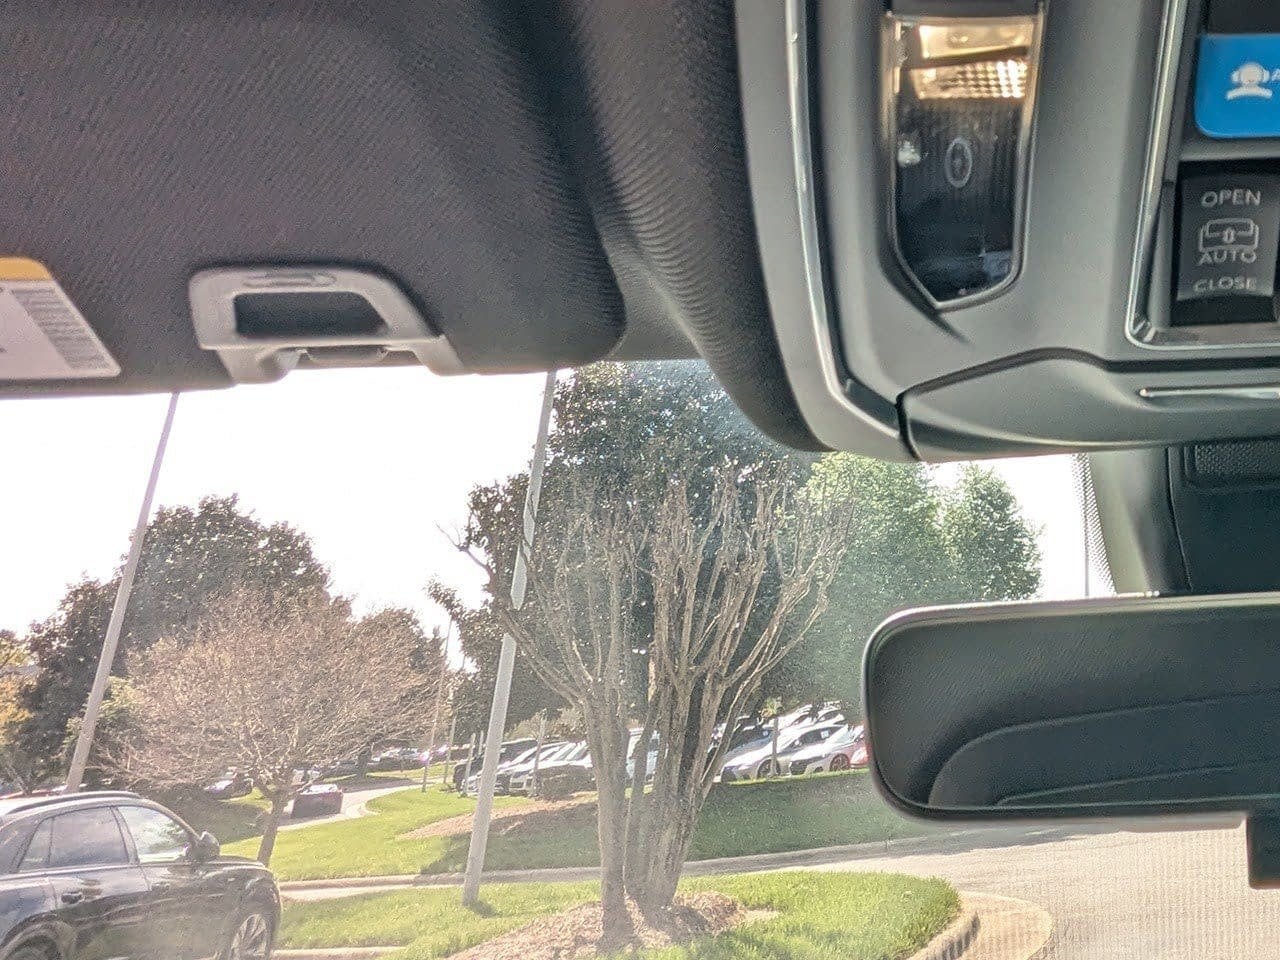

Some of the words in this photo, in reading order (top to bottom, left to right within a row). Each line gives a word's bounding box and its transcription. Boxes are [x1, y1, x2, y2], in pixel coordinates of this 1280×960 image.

[1200, 188, 1262, 208] OPEN
[1198, 248, 1258, 266] AUTO
[1193, 276, 1258, 294] CLOSE
